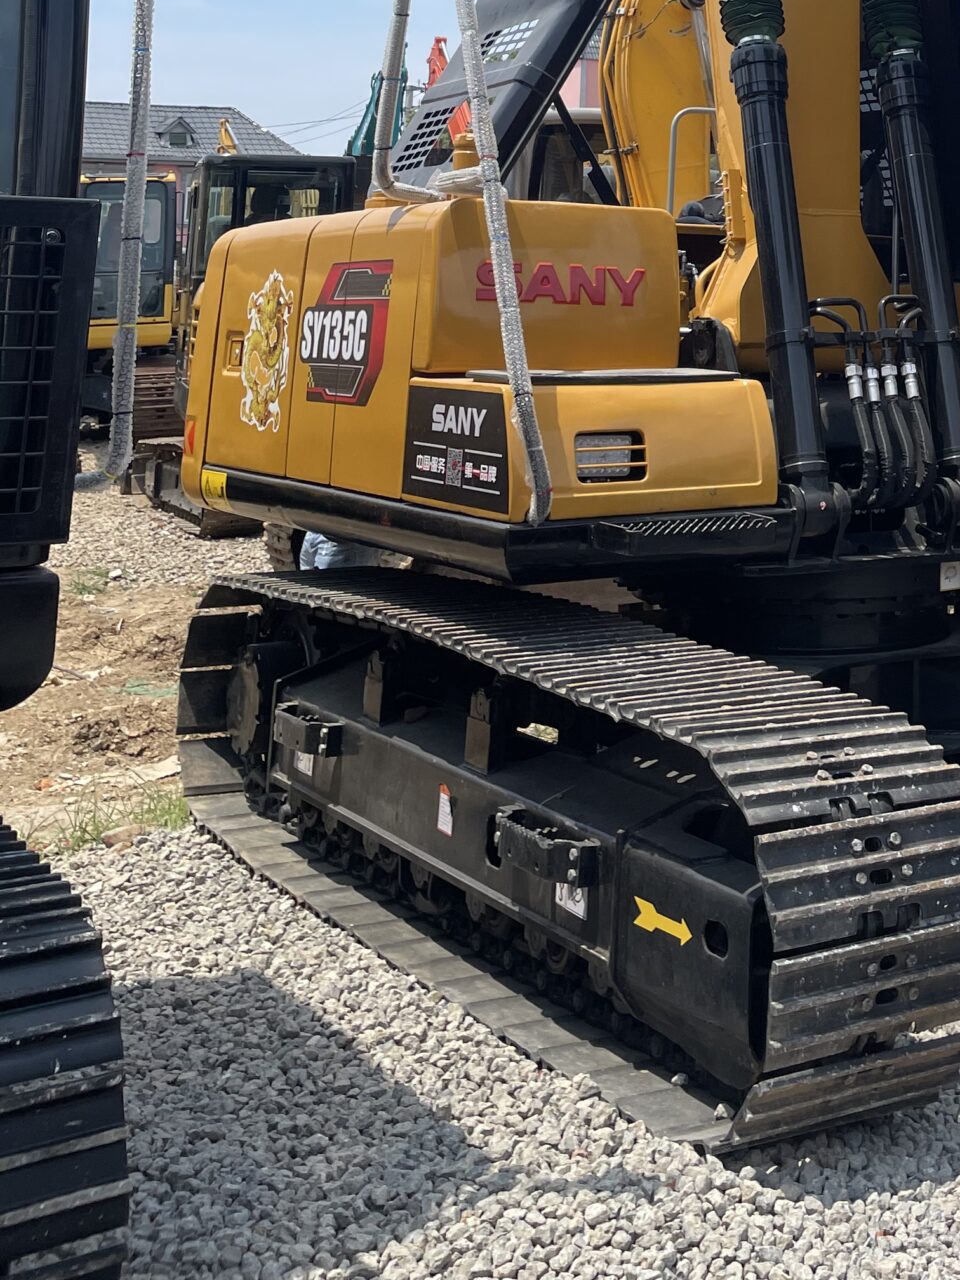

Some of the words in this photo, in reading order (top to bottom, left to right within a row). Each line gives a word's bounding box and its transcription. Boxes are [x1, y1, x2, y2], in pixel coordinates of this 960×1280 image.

[475, 260, 647, 307] SANY
[301, 309, 368, 362] SY135C
[431, 403, 487, 437] SANY
[464, 462, 498, 483] 第一品牌
